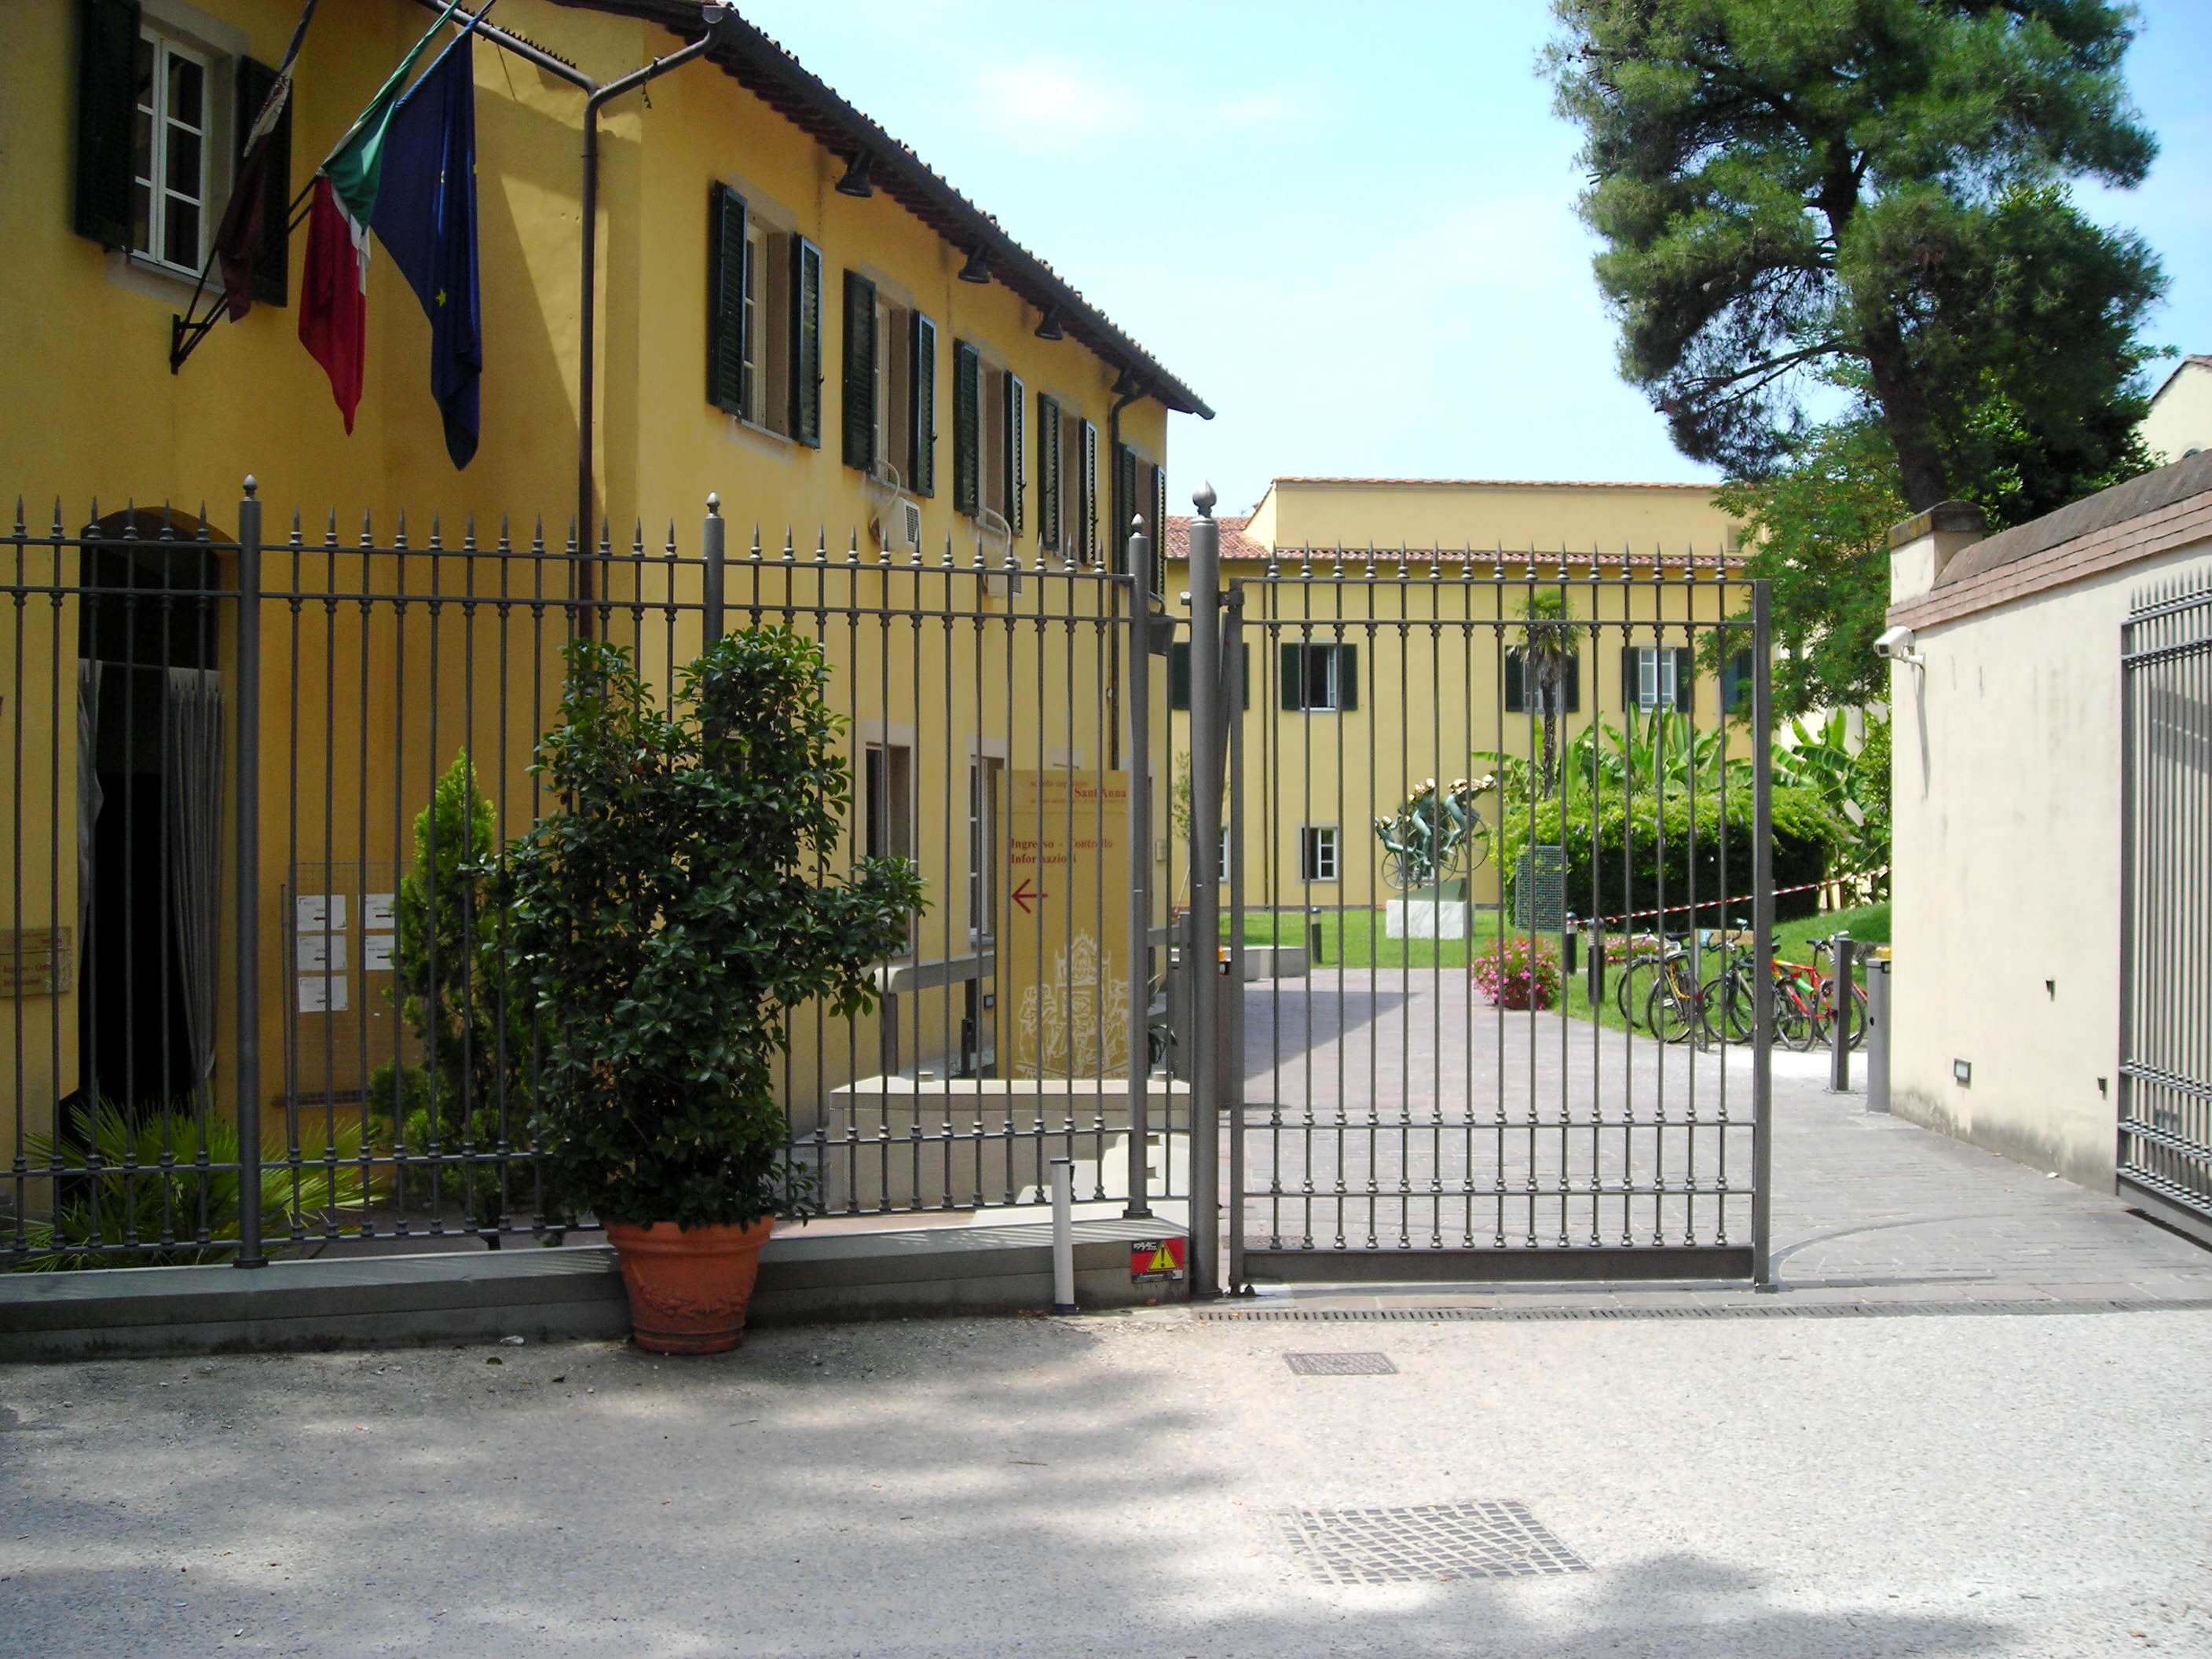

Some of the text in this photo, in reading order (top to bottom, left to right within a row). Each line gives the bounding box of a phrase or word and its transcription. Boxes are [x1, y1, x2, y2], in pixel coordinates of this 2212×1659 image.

[1011, 838, 1053, 851] Ingreso
[1011, 852, 1077, 863] Inforazioi
[1133, 1241, 1157, 1251] FAAC
